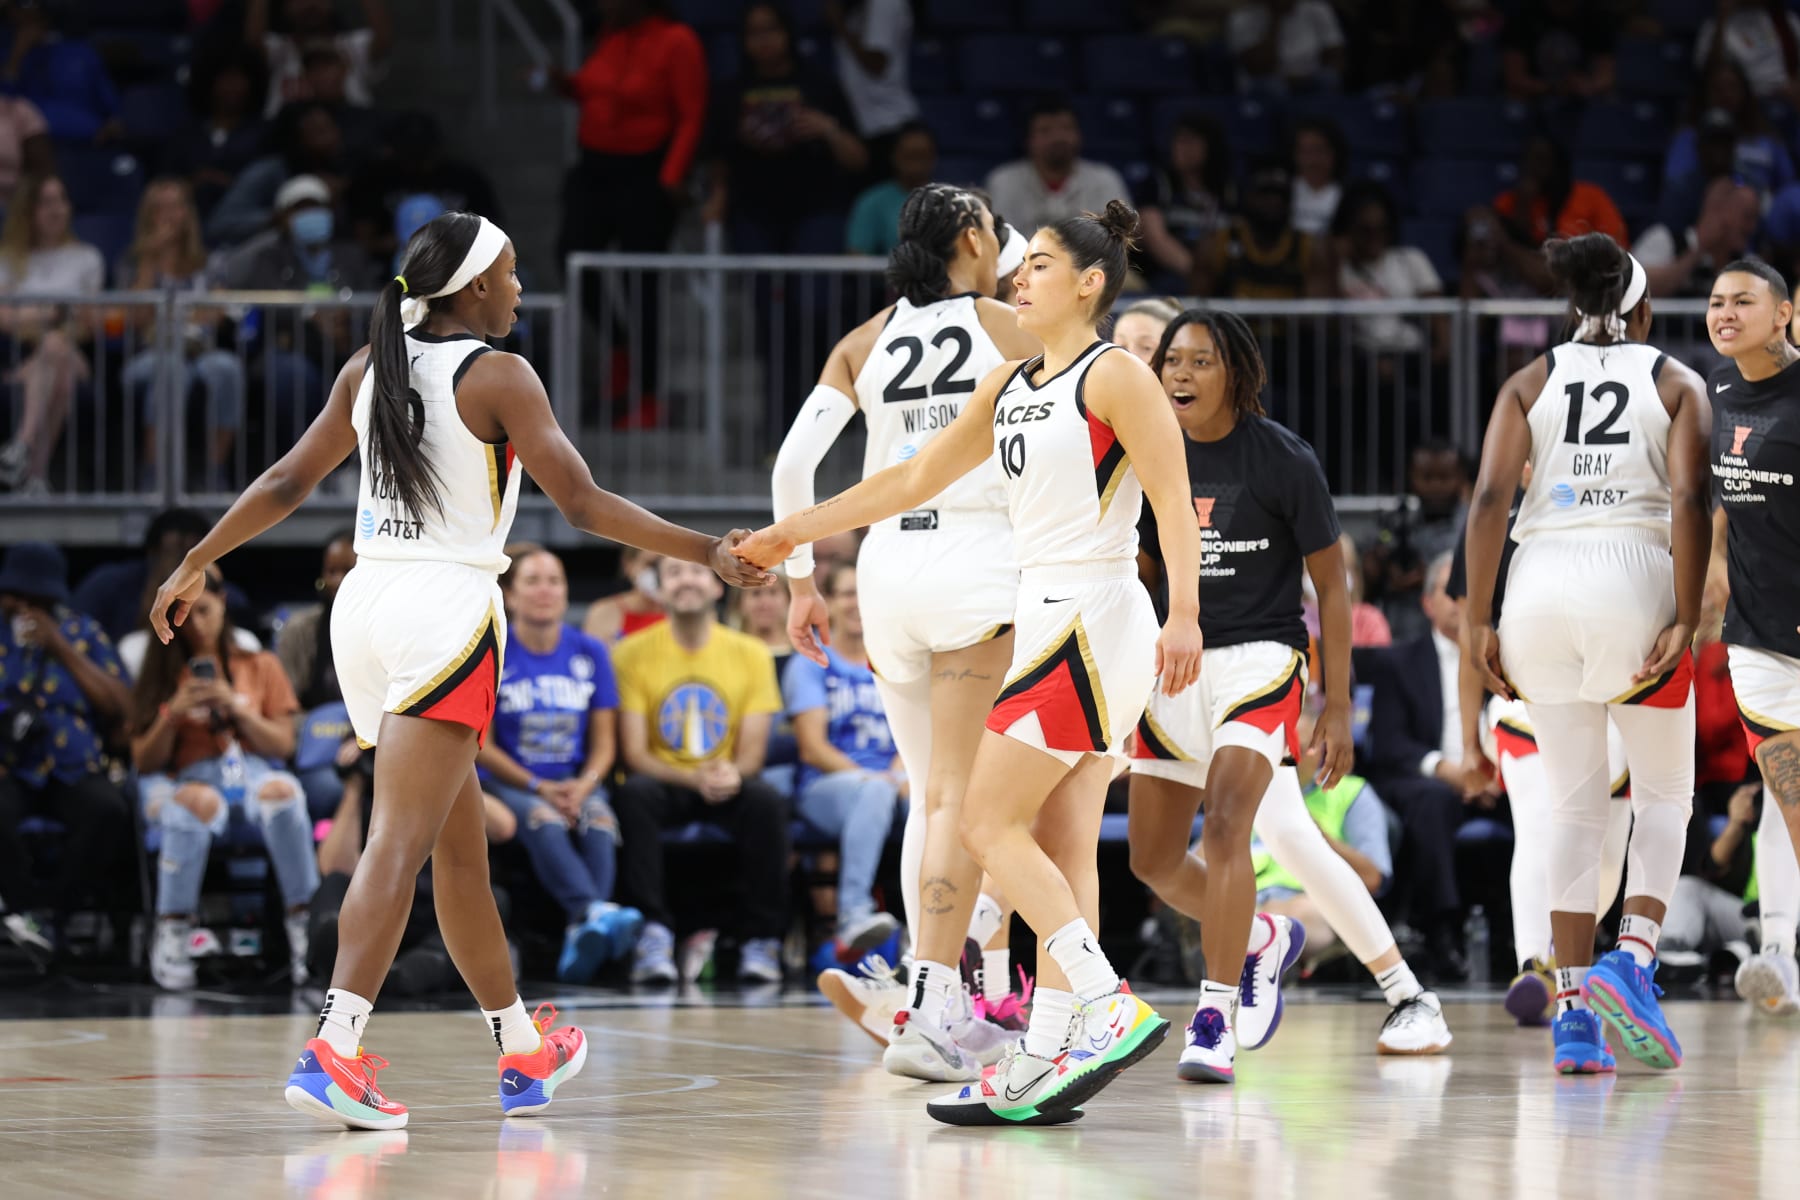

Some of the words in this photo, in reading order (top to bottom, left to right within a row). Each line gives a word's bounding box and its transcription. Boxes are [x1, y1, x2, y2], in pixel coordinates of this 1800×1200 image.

[883, 326, 976, 403] 22
[902, 403, 958, 433] WILSON
[995, 401, 1056, 428] ACES
[1564, 381, 1630, 445] 12
[999, 432, 1025, 480] 10
[1573, 453, 1612, 476] GRAY
[1724, 479, 1752, 491] CUP
[1580, 489, 1628, 506] AT&T
[378, 518, 424, 540] AT&T
[1200, 529, 1221, 539] NBA
[1200, 538, 1269, 552] SIONER'S
[1200, 553, 1221, 565] UP
[1200, 566, 1236, 576] oinbase
